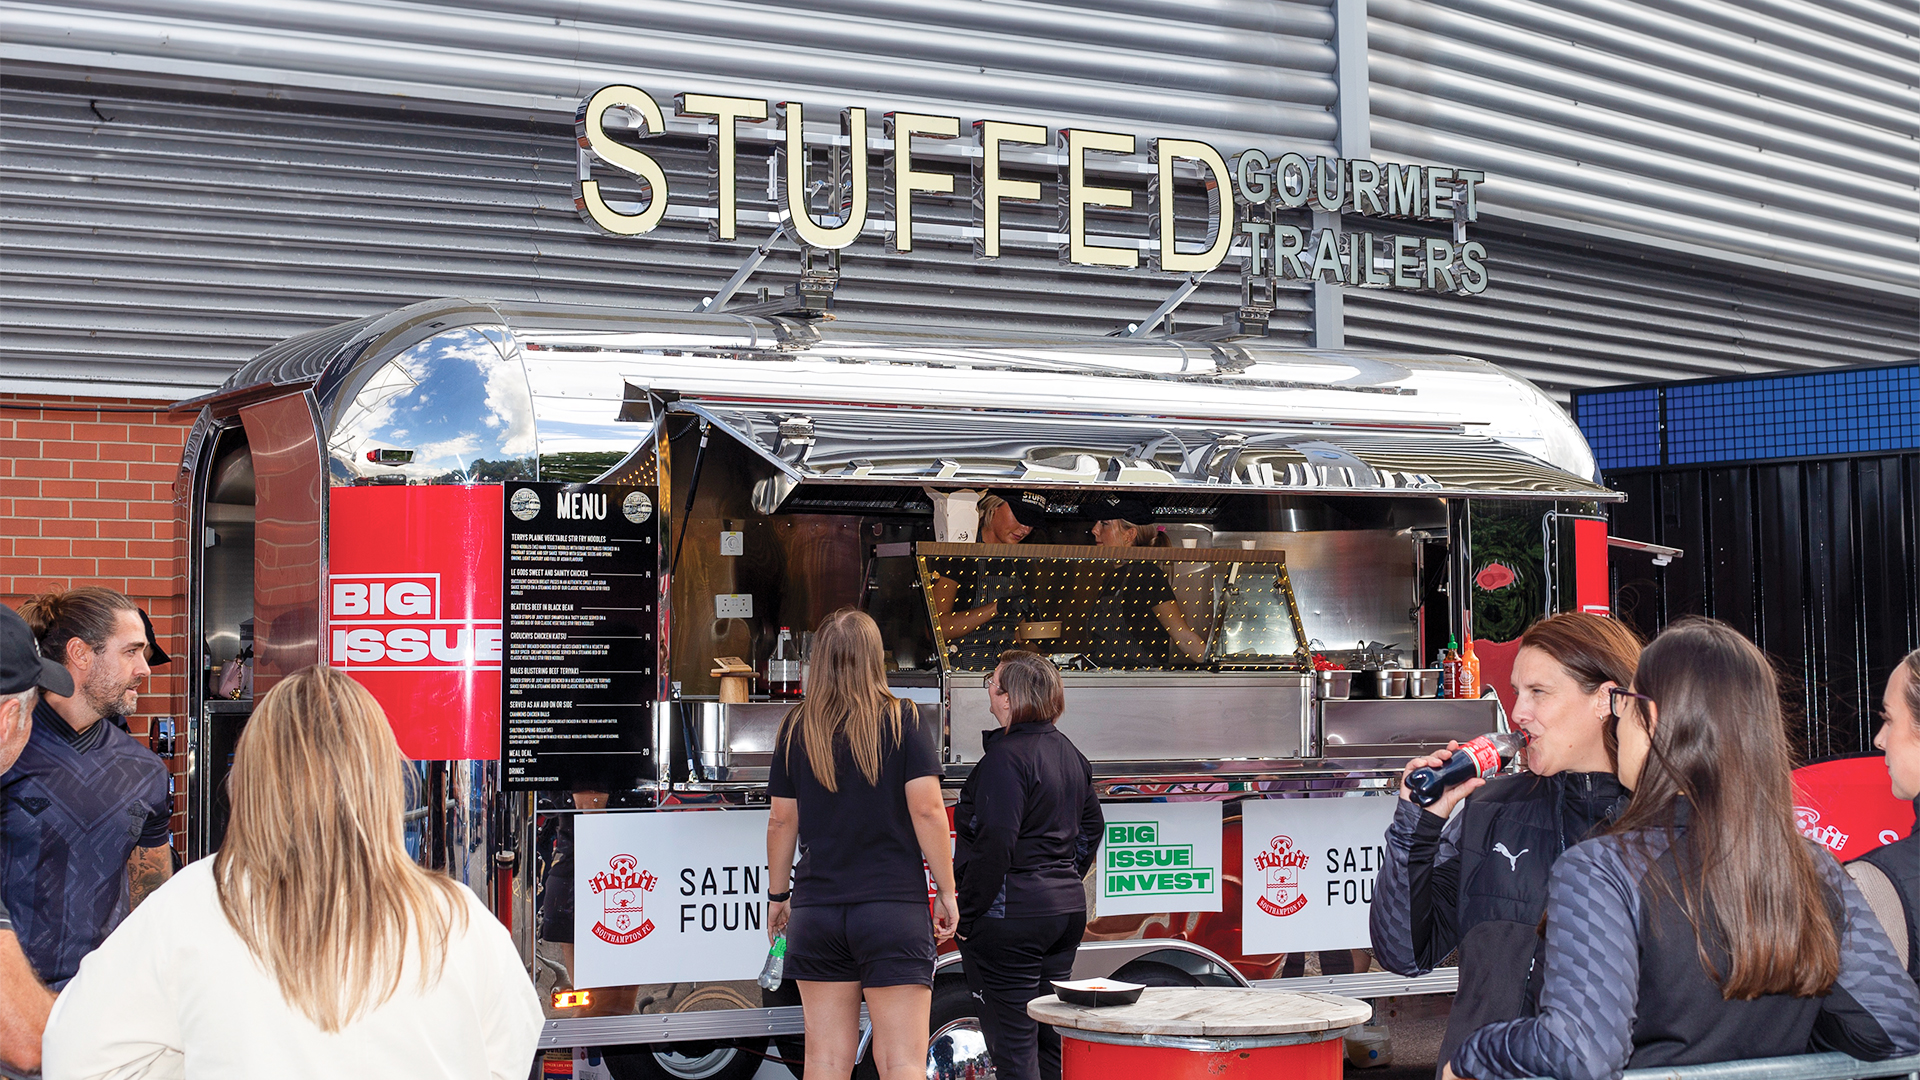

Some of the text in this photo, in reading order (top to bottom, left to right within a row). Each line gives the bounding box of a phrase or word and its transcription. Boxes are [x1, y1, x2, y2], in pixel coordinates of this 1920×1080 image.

[575, 83, 1235, 273] STUFFED
[1236, 147, 1485, 222] GOURMET
[1240, 221, 1488, 294] TRAILERS
[557, 491, 607, 520] MENU
[333, 582, 431, 616] BIG
[332, 628, 502, 663] ISSUE
[1108, 825, 1155, 843] BIG
[1108, 849, 1190, 868] ISSUE
[680, 865, 797, 896] SAIN
[1108, 872, 1211, 893] INVEST
[680, 902, 770, 933] FOUN
[1259, 898, 1305, 915] SOUTHAMPTON FC
[595, 924, 651, 943] SOUTHAMPTON FC
